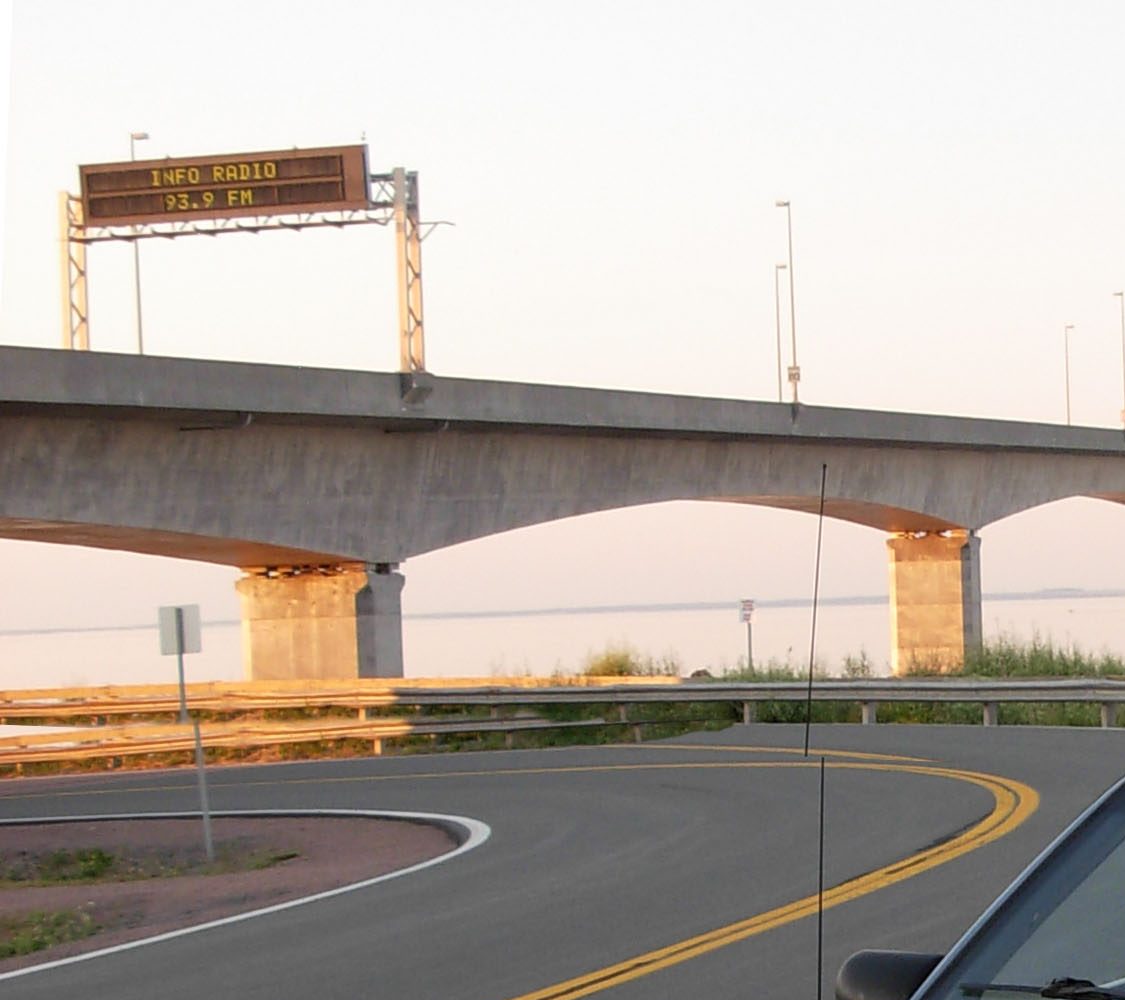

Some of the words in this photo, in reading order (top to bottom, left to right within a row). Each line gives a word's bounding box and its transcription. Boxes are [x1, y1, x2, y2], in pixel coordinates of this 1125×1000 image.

[151, 167, 200, 187] INFO
[212, 162, 277, 181] RADIO
[166, 191, 214, 211] 93.9
[227, 189, 253, 206] FM
